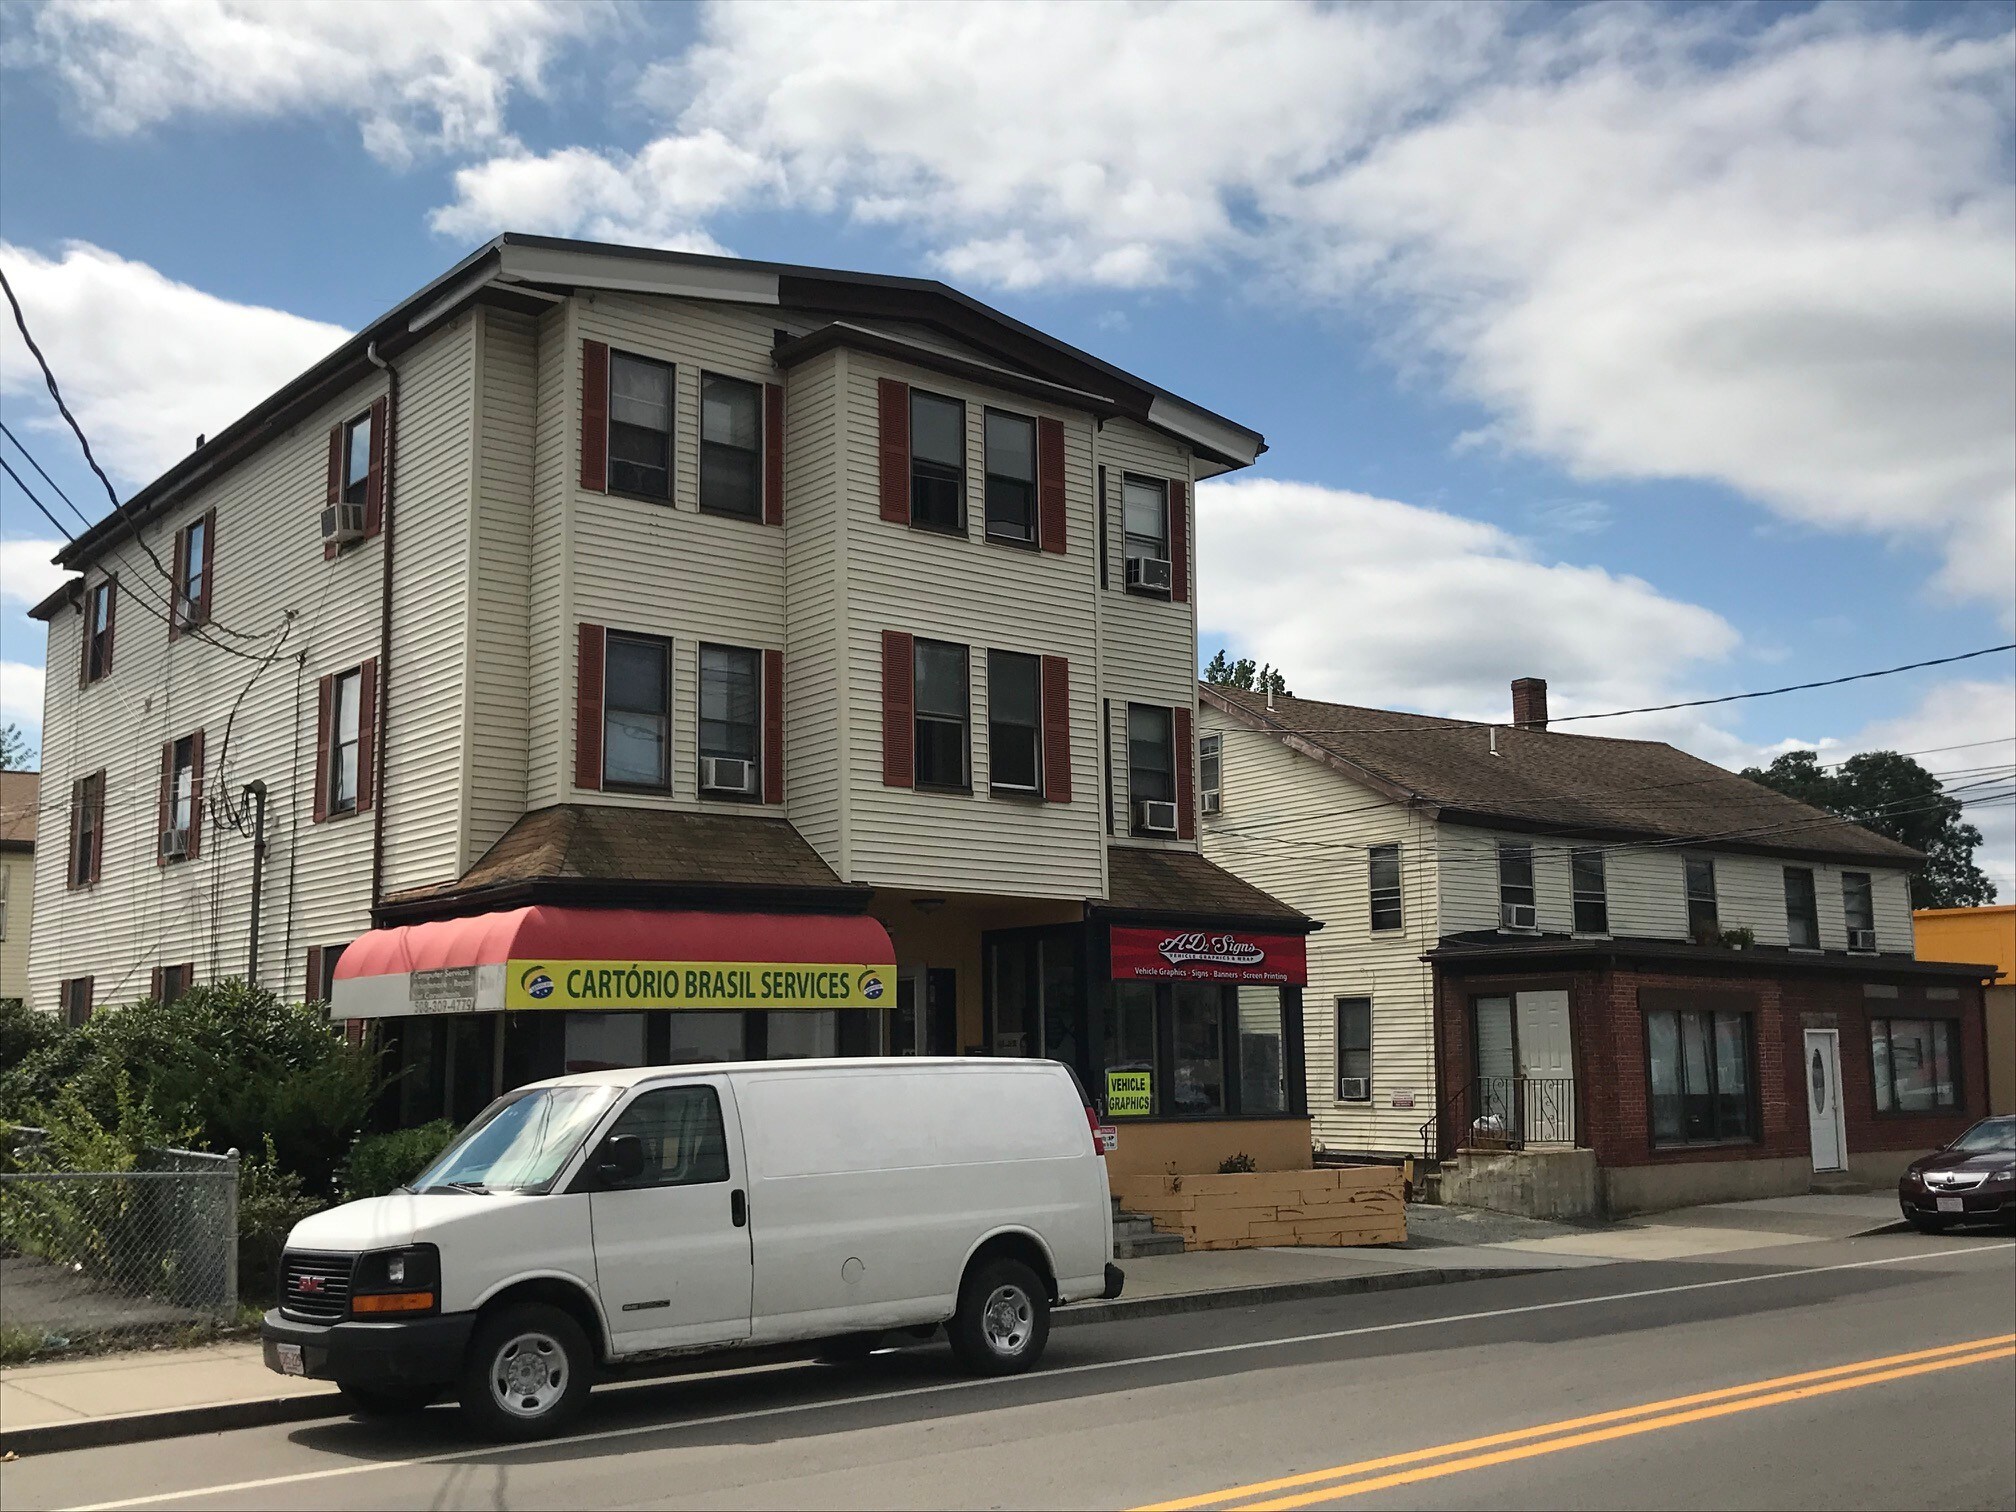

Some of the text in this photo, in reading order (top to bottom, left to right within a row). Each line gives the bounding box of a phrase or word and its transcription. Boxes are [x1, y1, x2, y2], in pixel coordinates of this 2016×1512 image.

[1211, 935, 1255, 954] Signs
[444, 969, 470, 978] Services
[567, 963, 679, 999] CARTÓRIO
[685, 970, 756, 998] BRASIL
[760, 971, 850, 999] SERVICES
[1134, 966, 1158, 975] Vehicle
[1159, 967, 1187, 978] Graphics
[1191, 969, 1209, 979] Signs
[1213, 970, 1238, 979] Banners
[1242, 971, 1263, 979] Screen
[1263, 972, 1288, 982] Printing
[1111, 1078, 1145, 1091] VEHICLE
[1109, 1096, 1149, 1110] GRAPHICS
